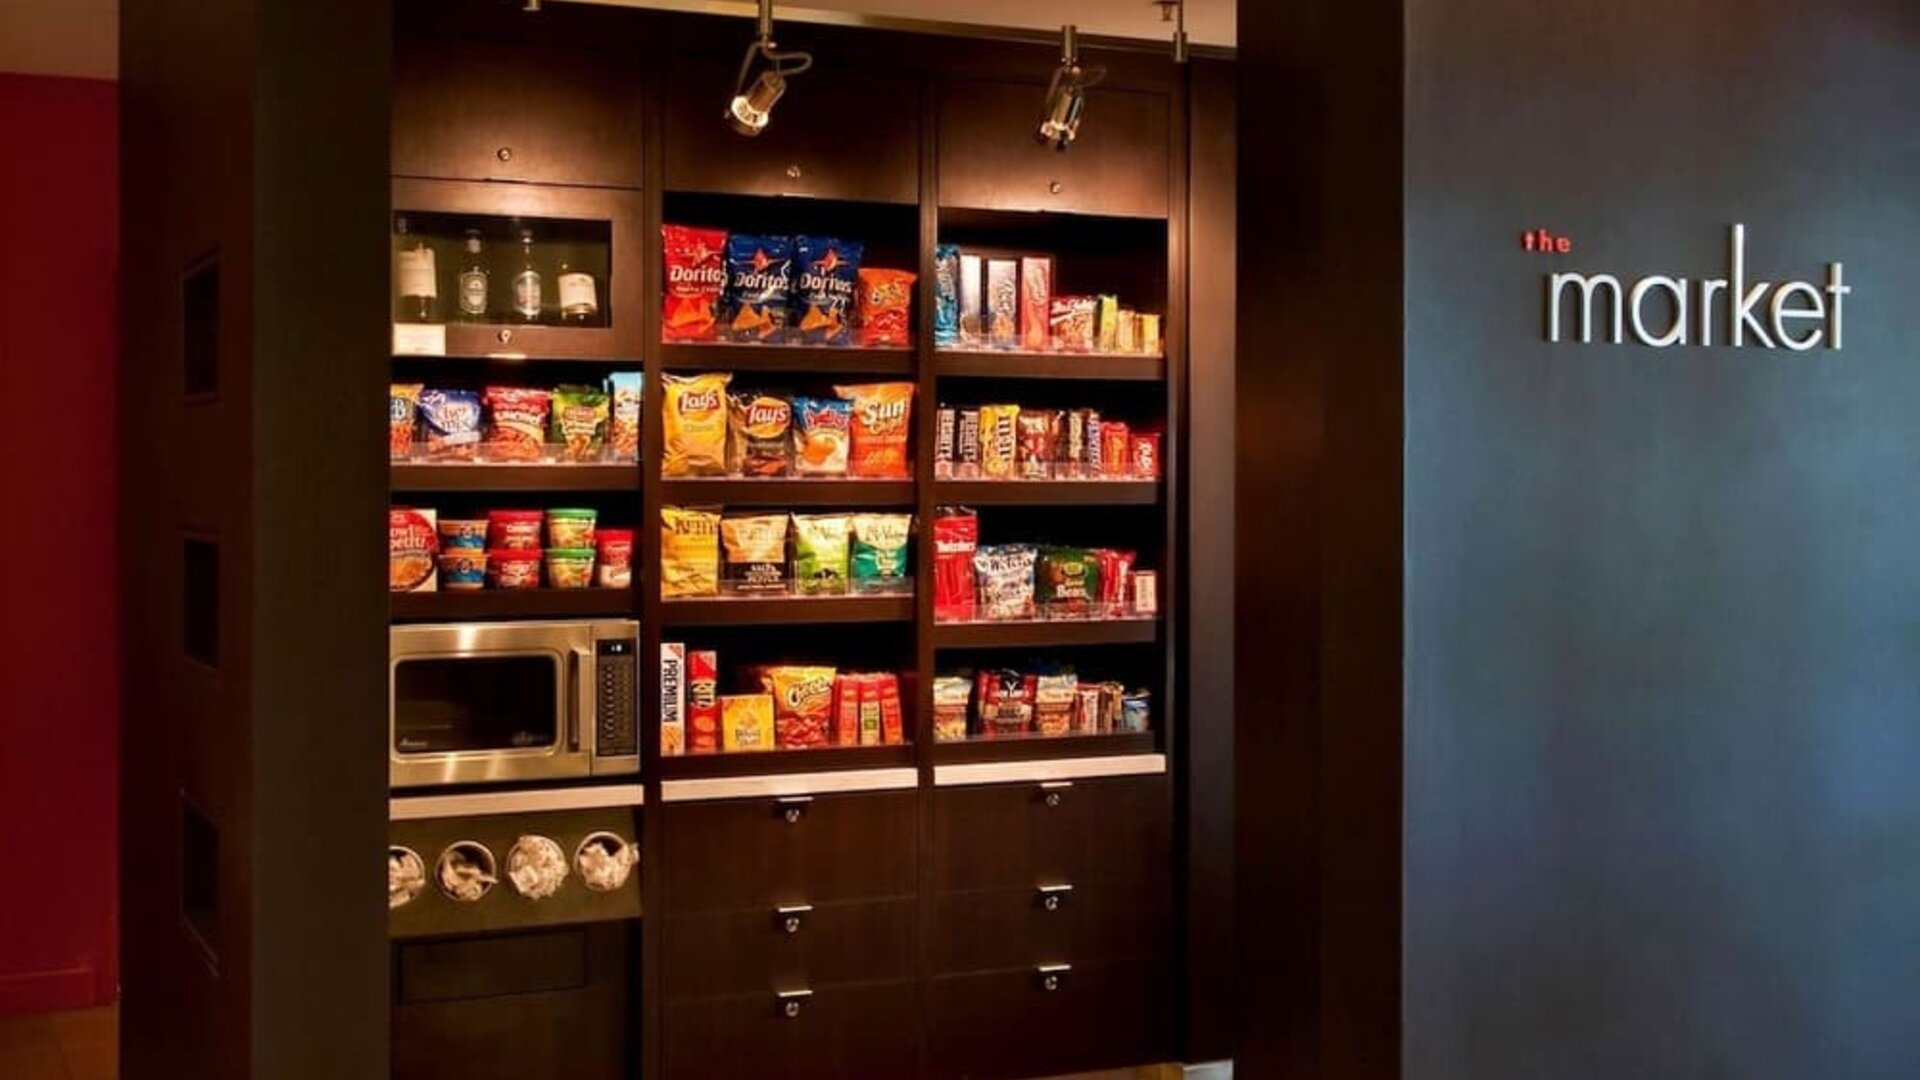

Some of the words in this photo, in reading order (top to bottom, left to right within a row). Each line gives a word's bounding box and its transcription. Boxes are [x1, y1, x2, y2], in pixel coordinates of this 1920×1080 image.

[1523, 229, 1571, 253] the
[734, 270, 788, 291] Doritos
[800, 273, 851, 293] Doritos
[1551, 223, 1850, 351] market
[662, 659, 678, 723] PREMIUM
